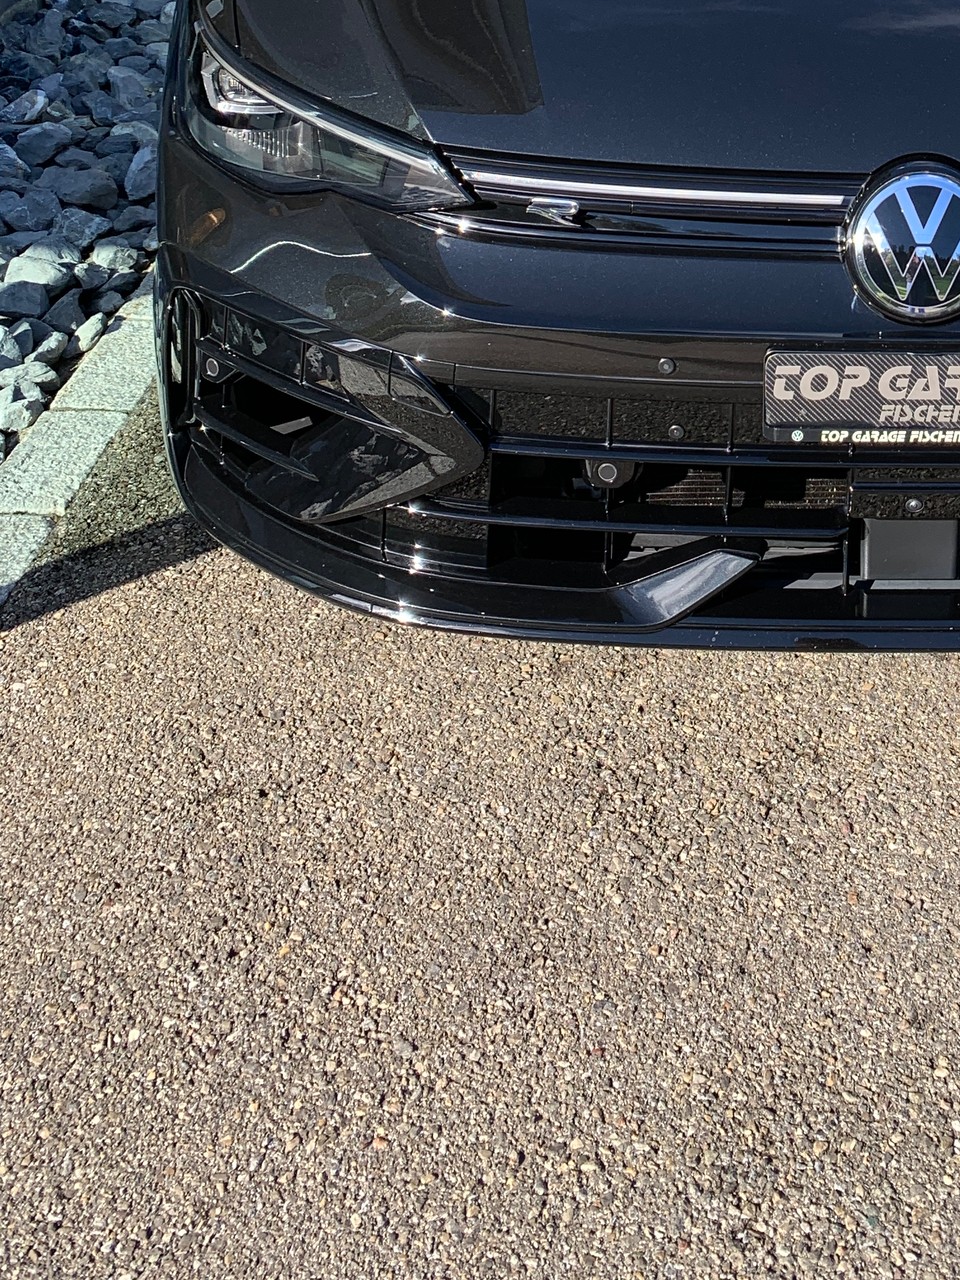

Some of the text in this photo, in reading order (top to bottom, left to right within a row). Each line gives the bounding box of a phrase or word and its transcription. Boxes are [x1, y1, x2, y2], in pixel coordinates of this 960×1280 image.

[773, 365, 871, 401] TOP
[821, 431, 849, 443] TOP
[852, 431, 907, 443] GARAGE
